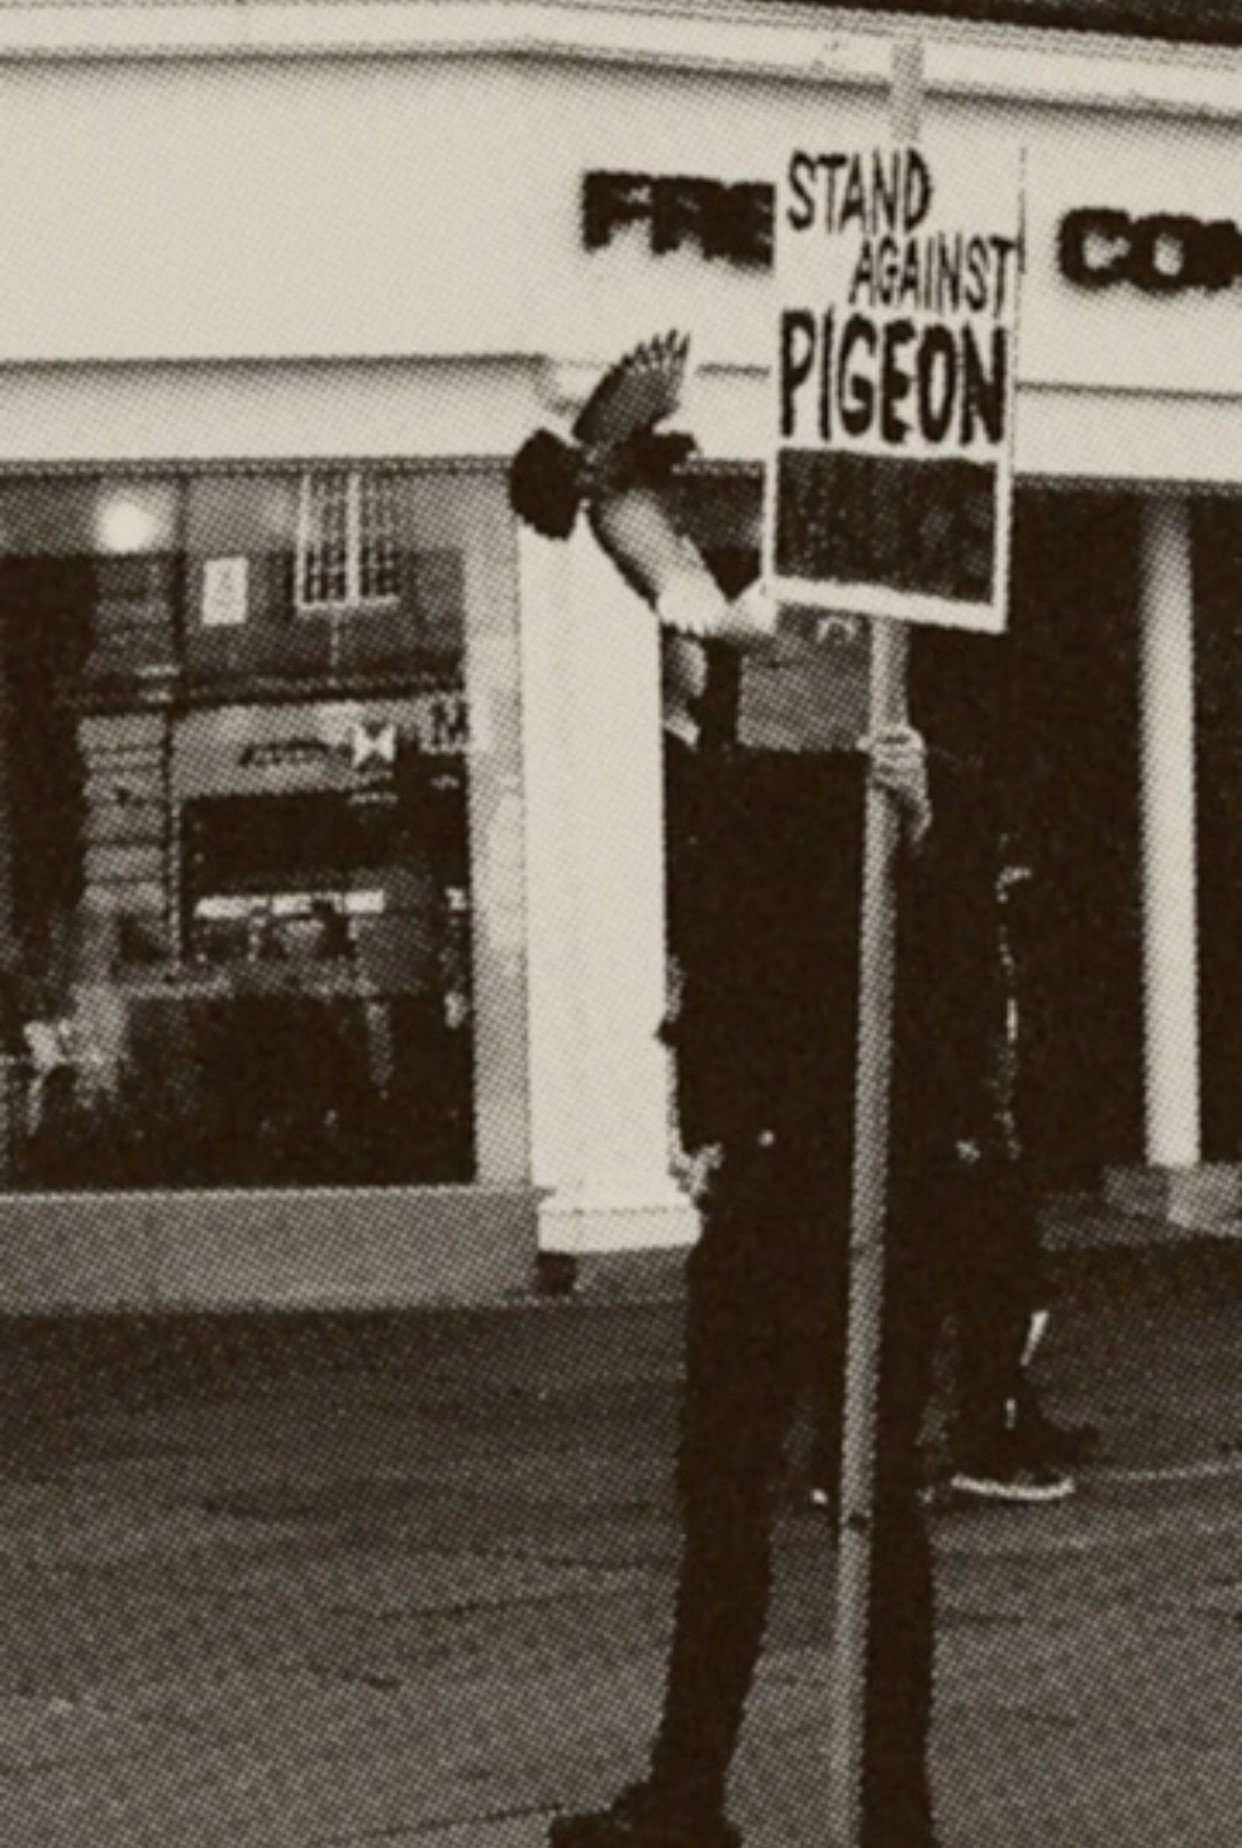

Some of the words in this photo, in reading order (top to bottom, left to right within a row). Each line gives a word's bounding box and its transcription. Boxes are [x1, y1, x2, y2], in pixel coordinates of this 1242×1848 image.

[787, 148, 932, 234] STAND
[849, 233, 1020, 317] AGAINST
[779, 305, 1006, 445] PIGEON
